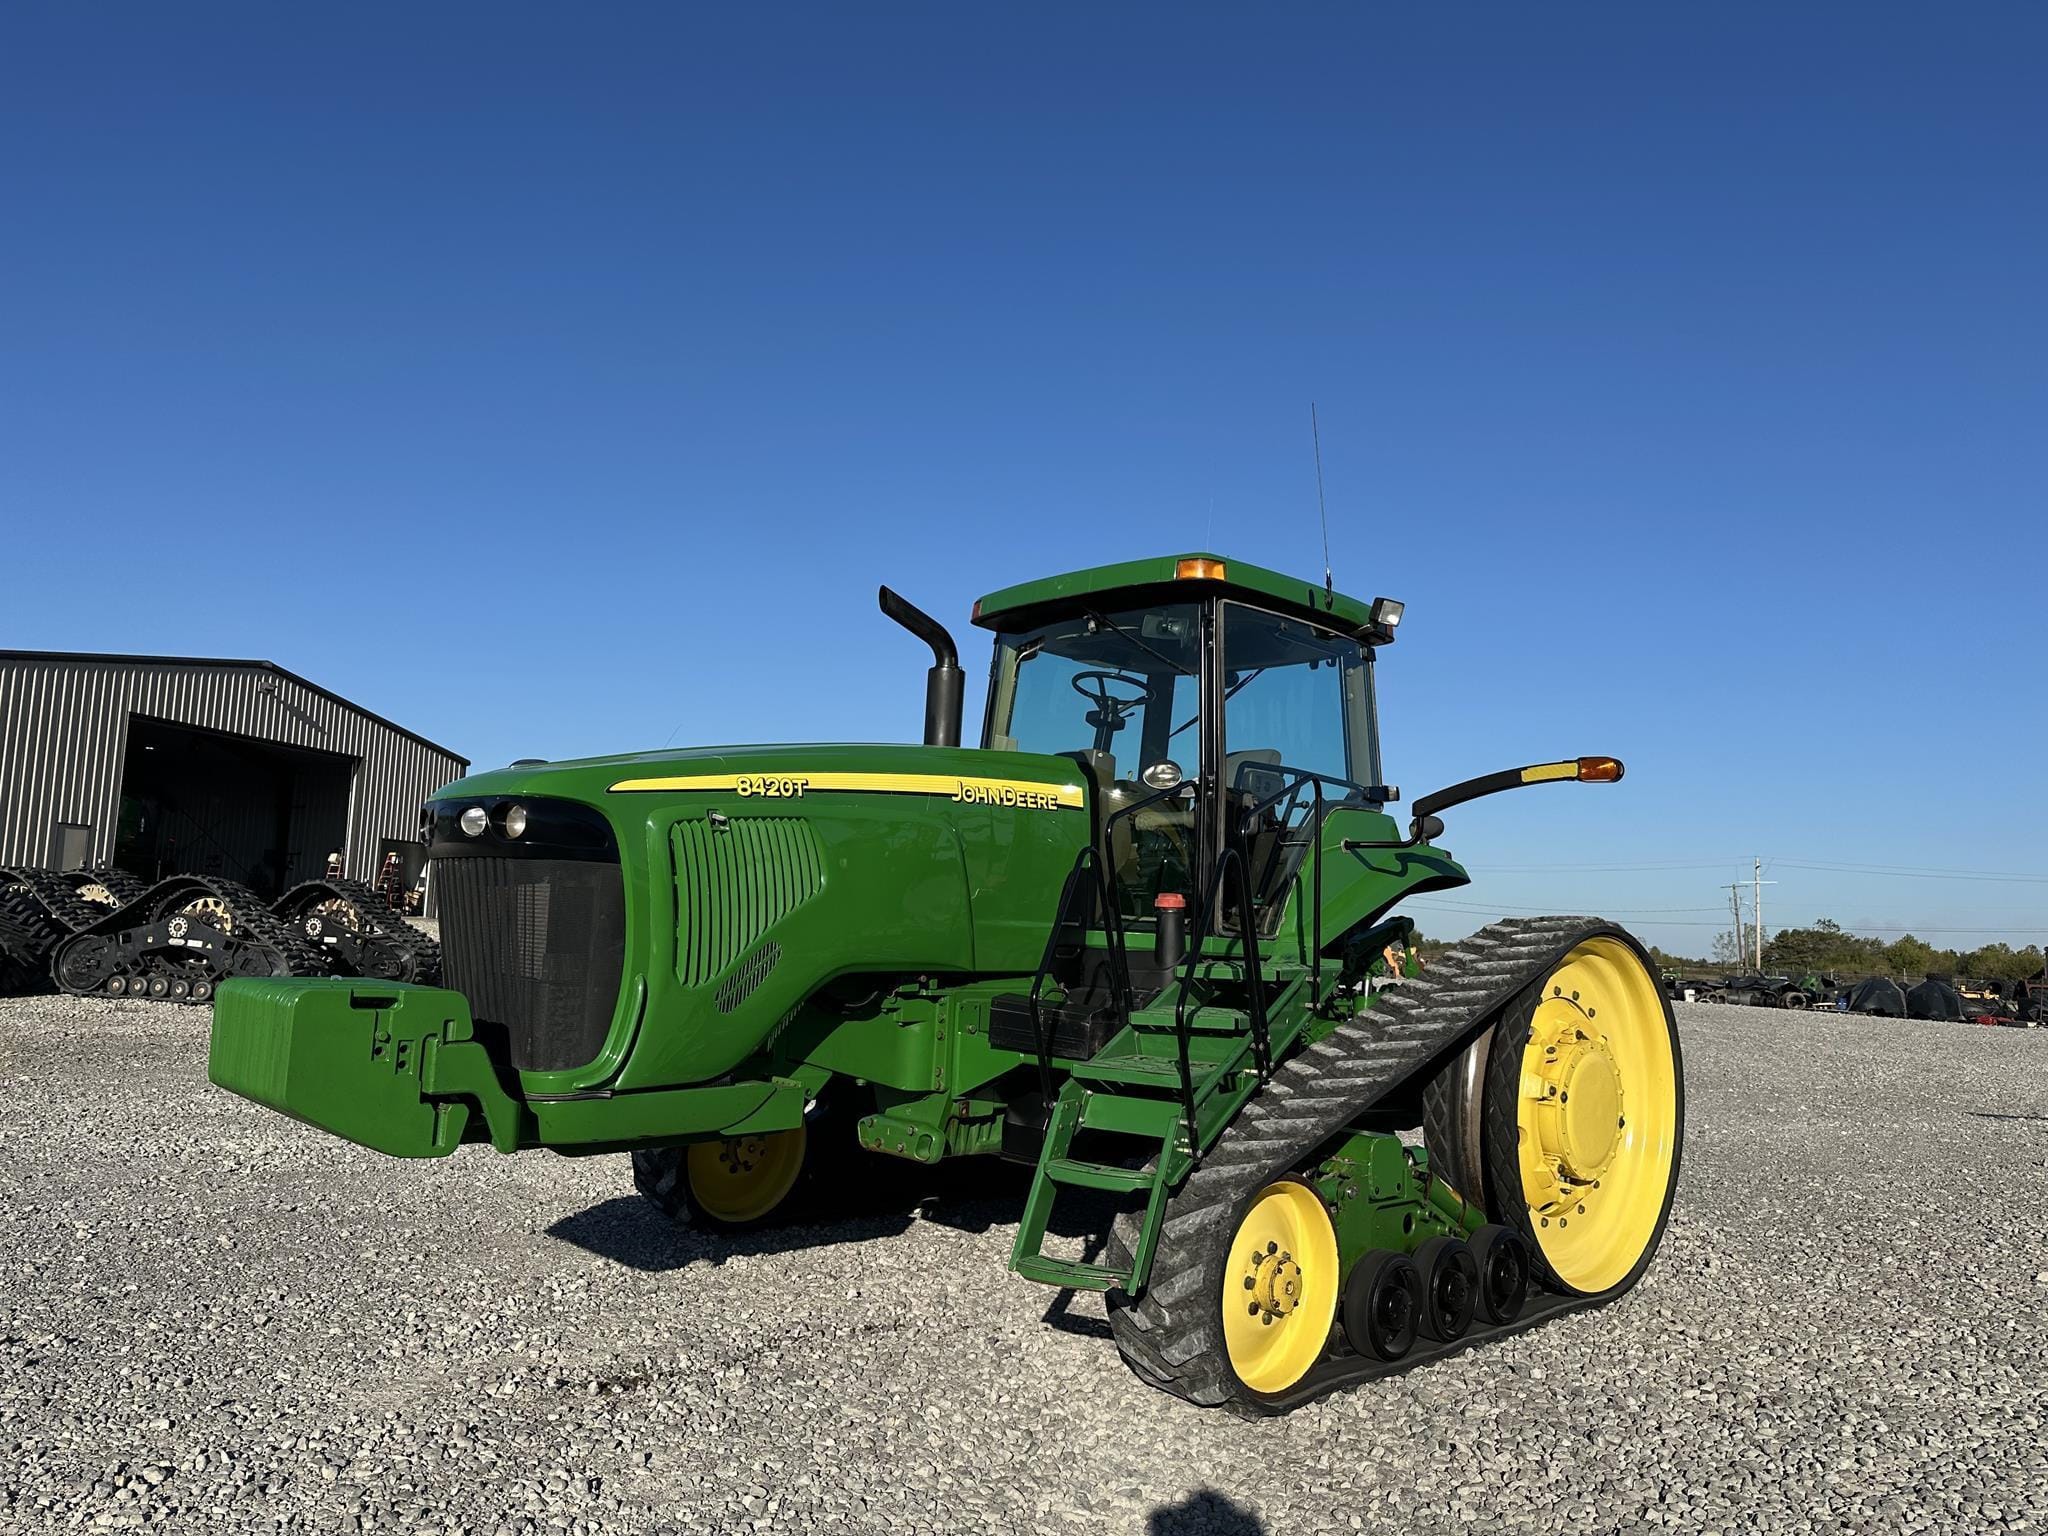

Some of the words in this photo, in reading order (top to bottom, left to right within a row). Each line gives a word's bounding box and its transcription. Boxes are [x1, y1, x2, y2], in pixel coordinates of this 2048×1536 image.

[736, 776, 808, 798] 8420T
[952, 780, 1001, 806] JOHN
[1002, 786, 1058, 810] DEERE
